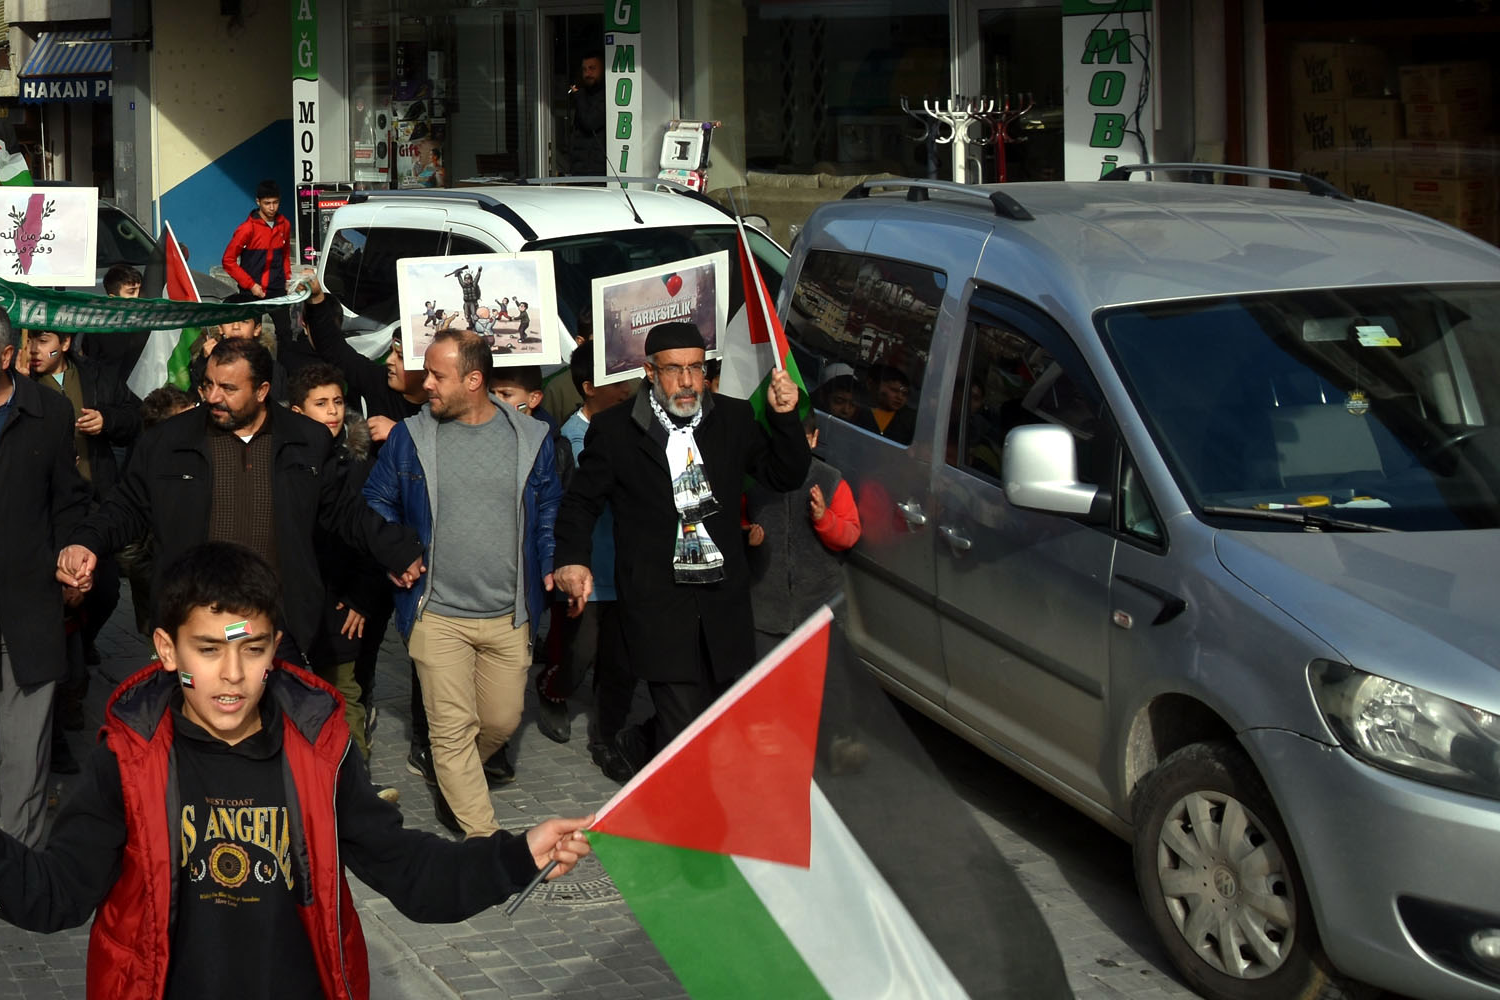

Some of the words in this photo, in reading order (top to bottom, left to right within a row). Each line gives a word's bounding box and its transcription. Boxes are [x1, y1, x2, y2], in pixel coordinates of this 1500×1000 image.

[23, 81, 88, 99] HAKAN
[399, 144, 419, 157] Gift
[0, 227, 18, 240] الله
[19, 299, 48, 326] YA
[631, 301, 691, 328] TARAFSIZLIK
[227, 799, 254, 807] COAST
